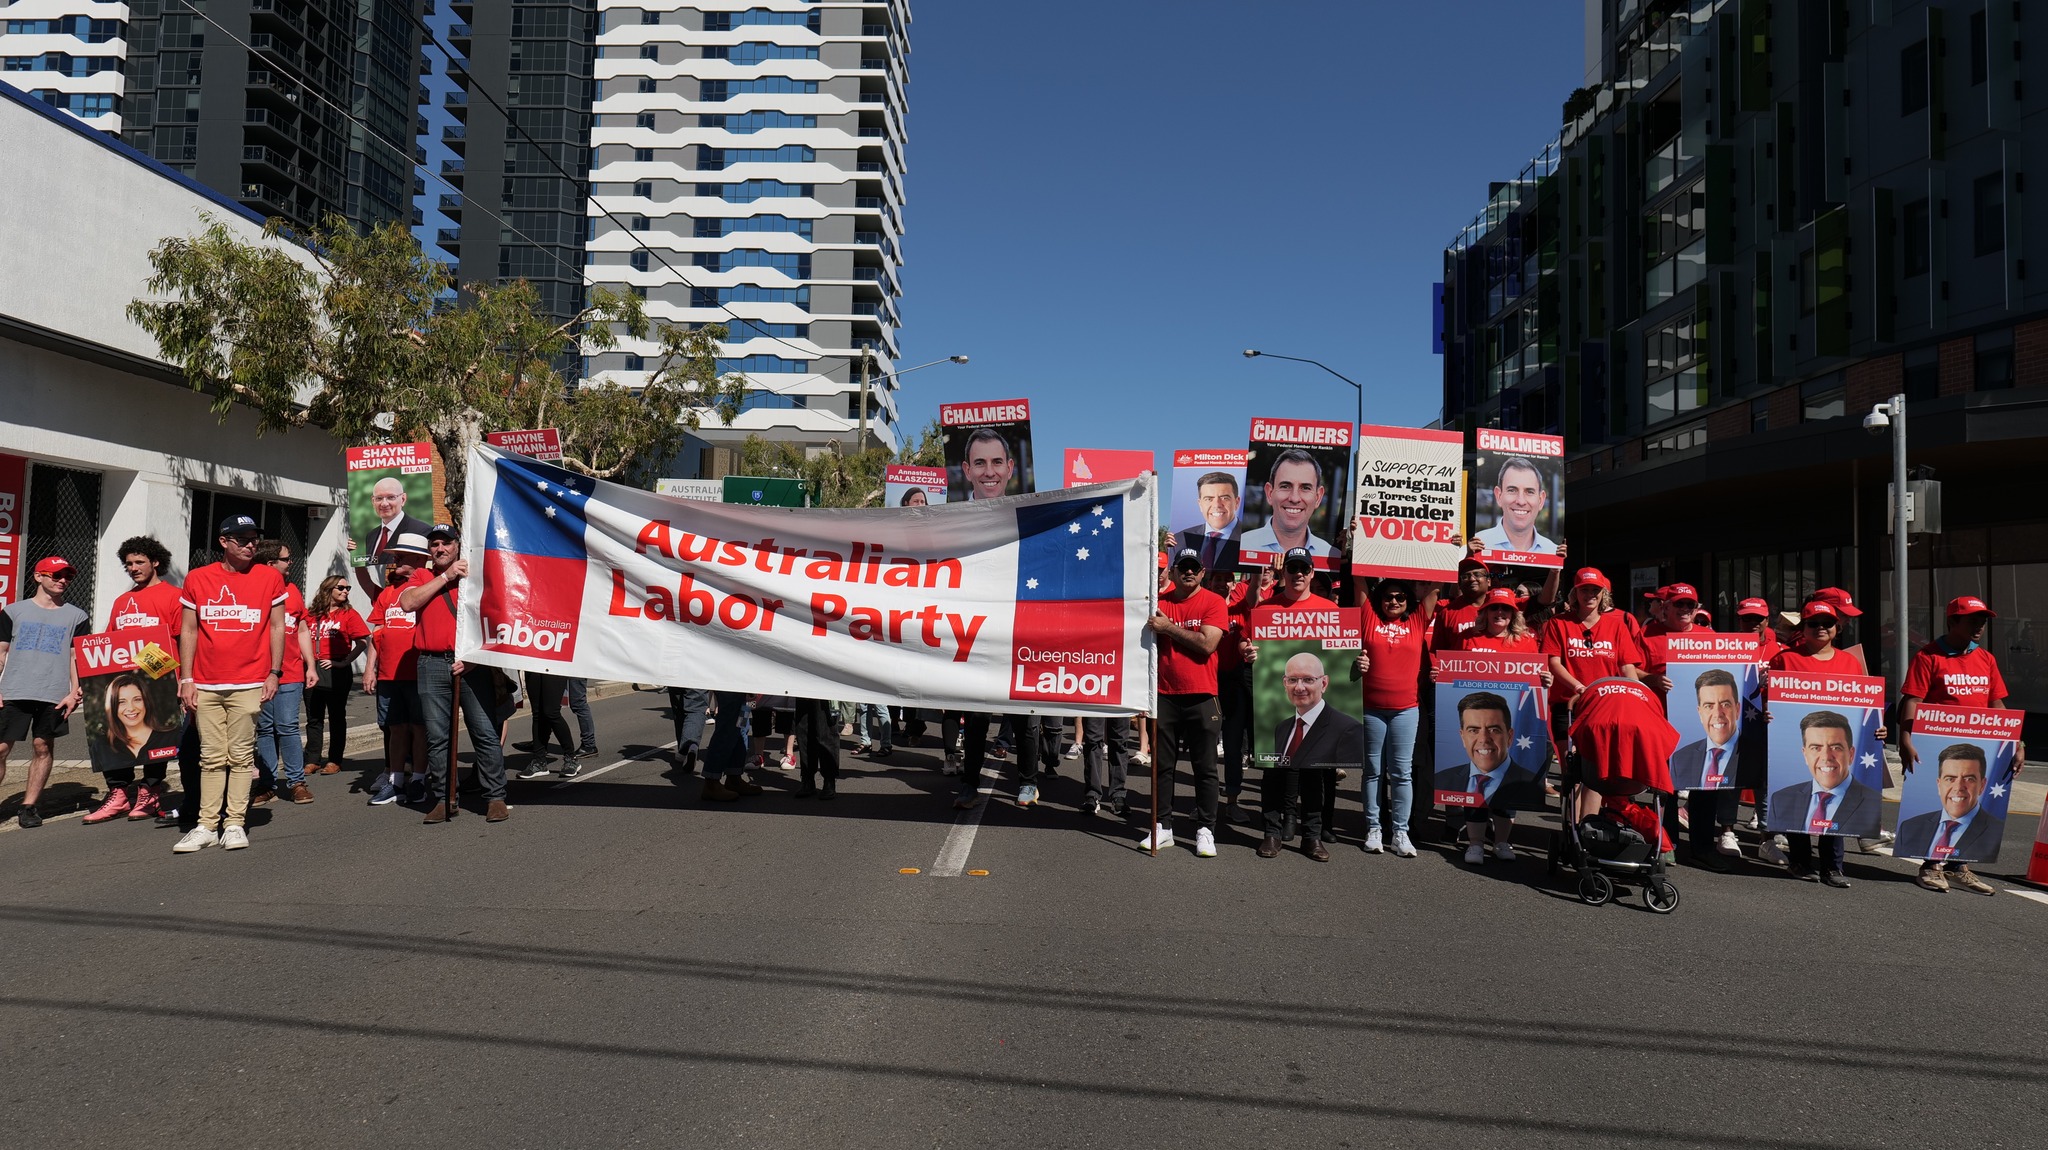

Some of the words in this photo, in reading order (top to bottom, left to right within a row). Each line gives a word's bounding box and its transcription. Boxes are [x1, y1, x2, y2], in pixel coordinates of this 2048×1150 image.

[944, 404, 1026, 424] CHALMERS
[501, 433, 544, 444] SHAYNE
[1254, 424, 1348, 445] CHALMERS
[1480, 434, 1561, 455] CHALMERS
[362, 446, 415, 458] SHAYNE
[349, 456, 415, 470] NEUMANN
[1362, 461, 1369, 471] I
[1372, 460, 1437, 476] SUPPORT
[1435, 466, 1456, 477] AN
[889, 474, 945, 484] PALASZCZUK
[1361, 474, 1455, 493] Aboriginal
[671, 485, 722, 494] AUSTRALIA
[1378, 491, 1417, 502] Torres
[1420, 494, 1453, 505] Strait
[1360, 500, 1454, 521] Islander
[1359, 517, 1454, 544] VOICE
[634, 519, 963, 589] Australian
[1502, 552, 1527, 561] Labor
[205, 608, 242, 617] Labor
[609, 569, 784, 631] Labor
[811, 592, 988, 663] Party
[1272, 612, 1339, 624] SHAYNE
[527, 616, 571, 629] Australian
[484, 617, 569, 652] Labor
[1255, 626, 1340, 638] NEUMANN
[82, 637, 111, 647] Anika
[1668, 638, 1712, 650] Milton
[1716, 639, 1742, 650] Dick
[1745, 642, 1758, 650] MP
[82, 640, 160, 668] Well
[1018, 646, 1115, 664] Queensland
[1568, 649, 1594, 657] Dick
[1440, 659, 1500, 673] MILTON
[1504, 662, 1544, 675] DICK
[1015, 665, 1115, 696] Labor
[1770, 677, 1821, 690] Milton
[1826, 680, 1861, 693] Dick
[1865, 685, 1882, 694] MP
[1944, 674, 1988, 685] Milton
[1598, 687, 1626, 696] Dick
[1947, 687, 1972, 695] Dick
[1854, 696, 1874, 704] Oxley
[1916, 709, 1966, 724] Milton
[1969, 713, 2002, 726] Dick
[2004, 718, 2021, 728] MP
[151, 749, 174, 757] Labor
[1441, 794, 1465, 802] Labor
